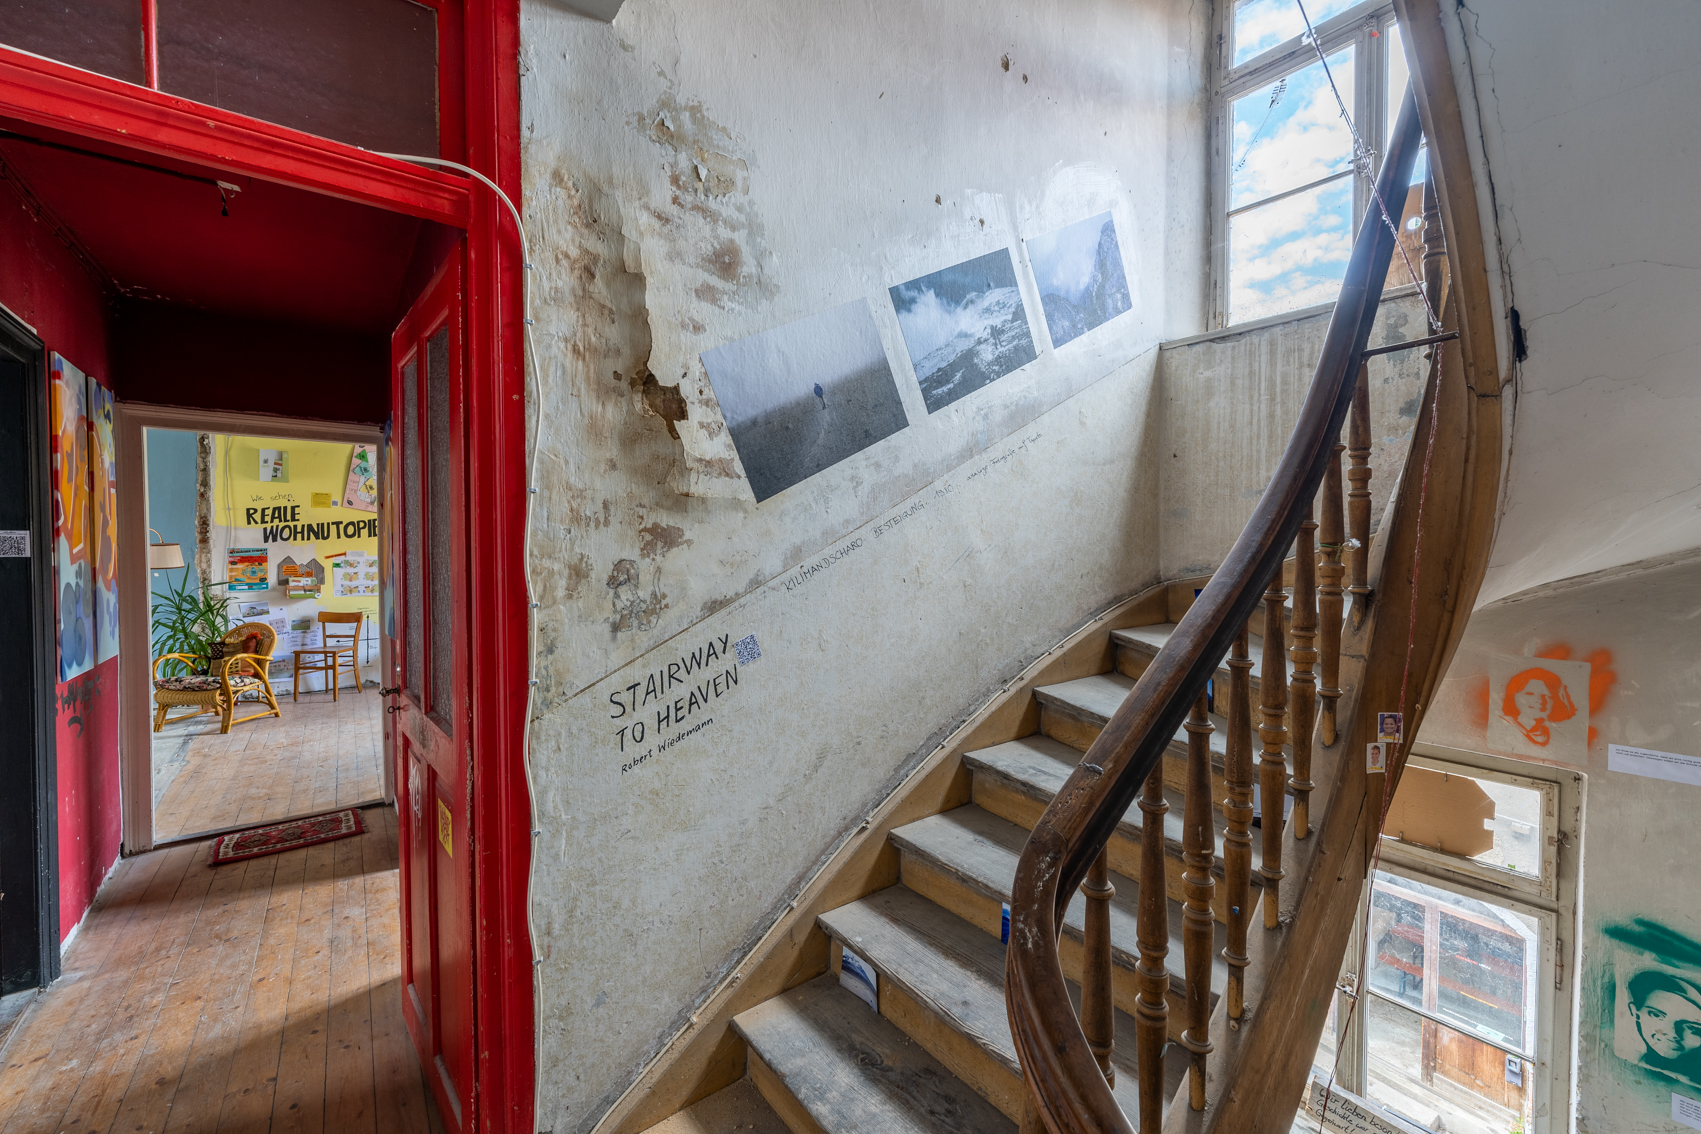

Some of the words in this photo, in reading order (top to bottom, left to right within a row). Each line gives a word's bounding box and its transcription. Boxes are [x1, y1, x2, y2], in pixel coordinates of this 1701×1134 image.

[250, 494, 264, 503] Wie
[245, 504, 301, 526] REALE
[609, 633, 729, 719] STAIRWAY
[615, 721, 645, 752] TO
[656, 663, 738, 734] HEAVEN
[621, 748, 653, 776] Robert
[657, 717, 714, 753] Wiedemann
[1316, 1098, 1354, 1126] Gschichte
[1340, 1099, 1367, 1122] lieben
